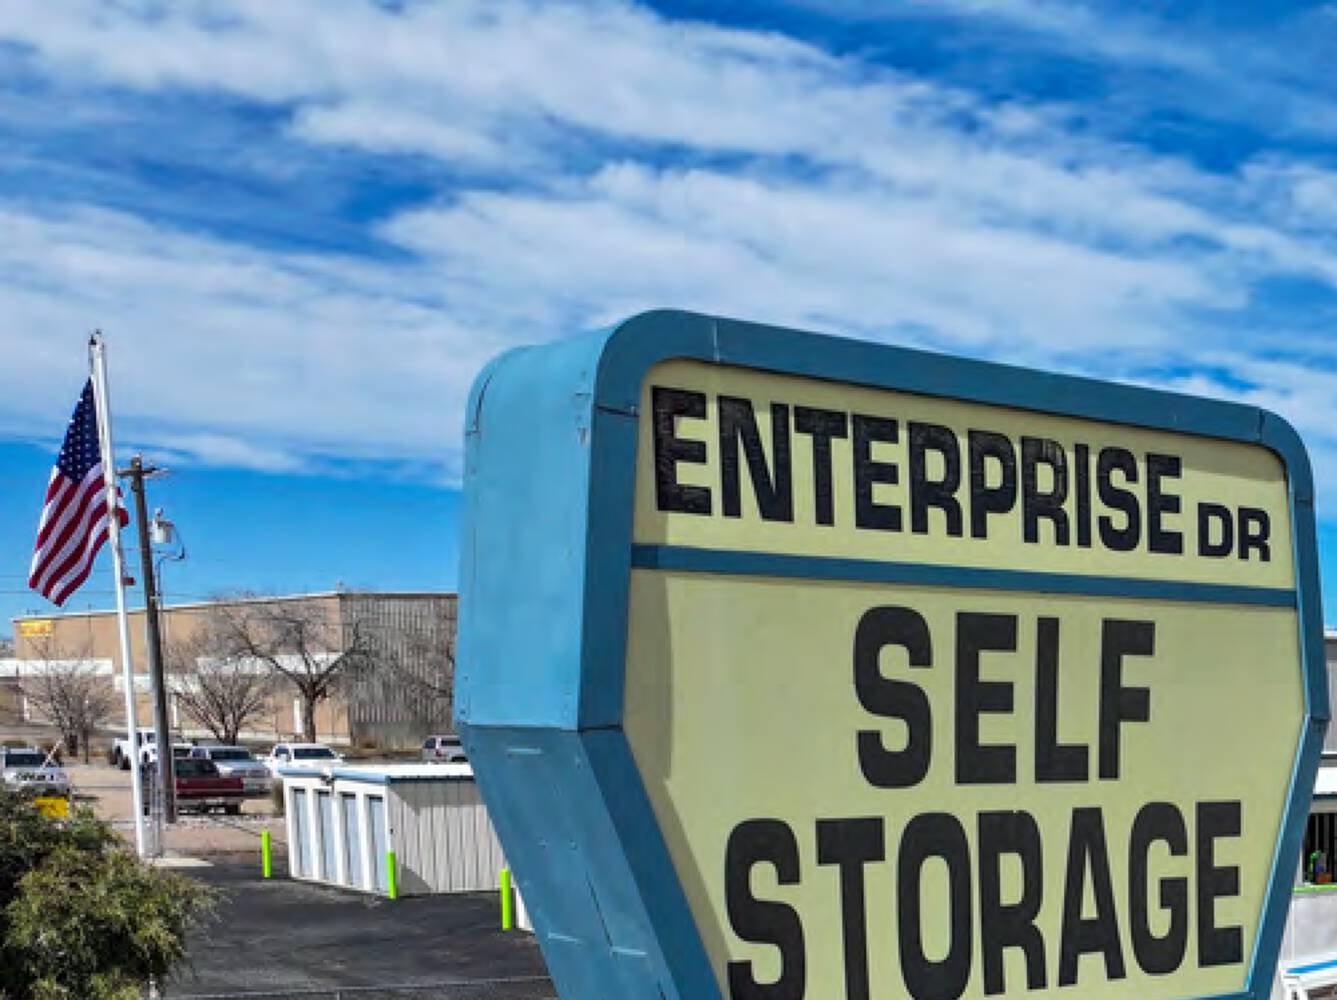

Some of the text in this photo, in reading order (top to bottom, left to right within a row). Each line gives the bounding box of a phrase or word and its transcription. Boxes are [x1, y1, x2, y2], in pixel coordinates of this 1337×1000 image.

[652, 385, 1271, 561] ENTERPRISE DR
[853, 606, 1155, 789] SELF
